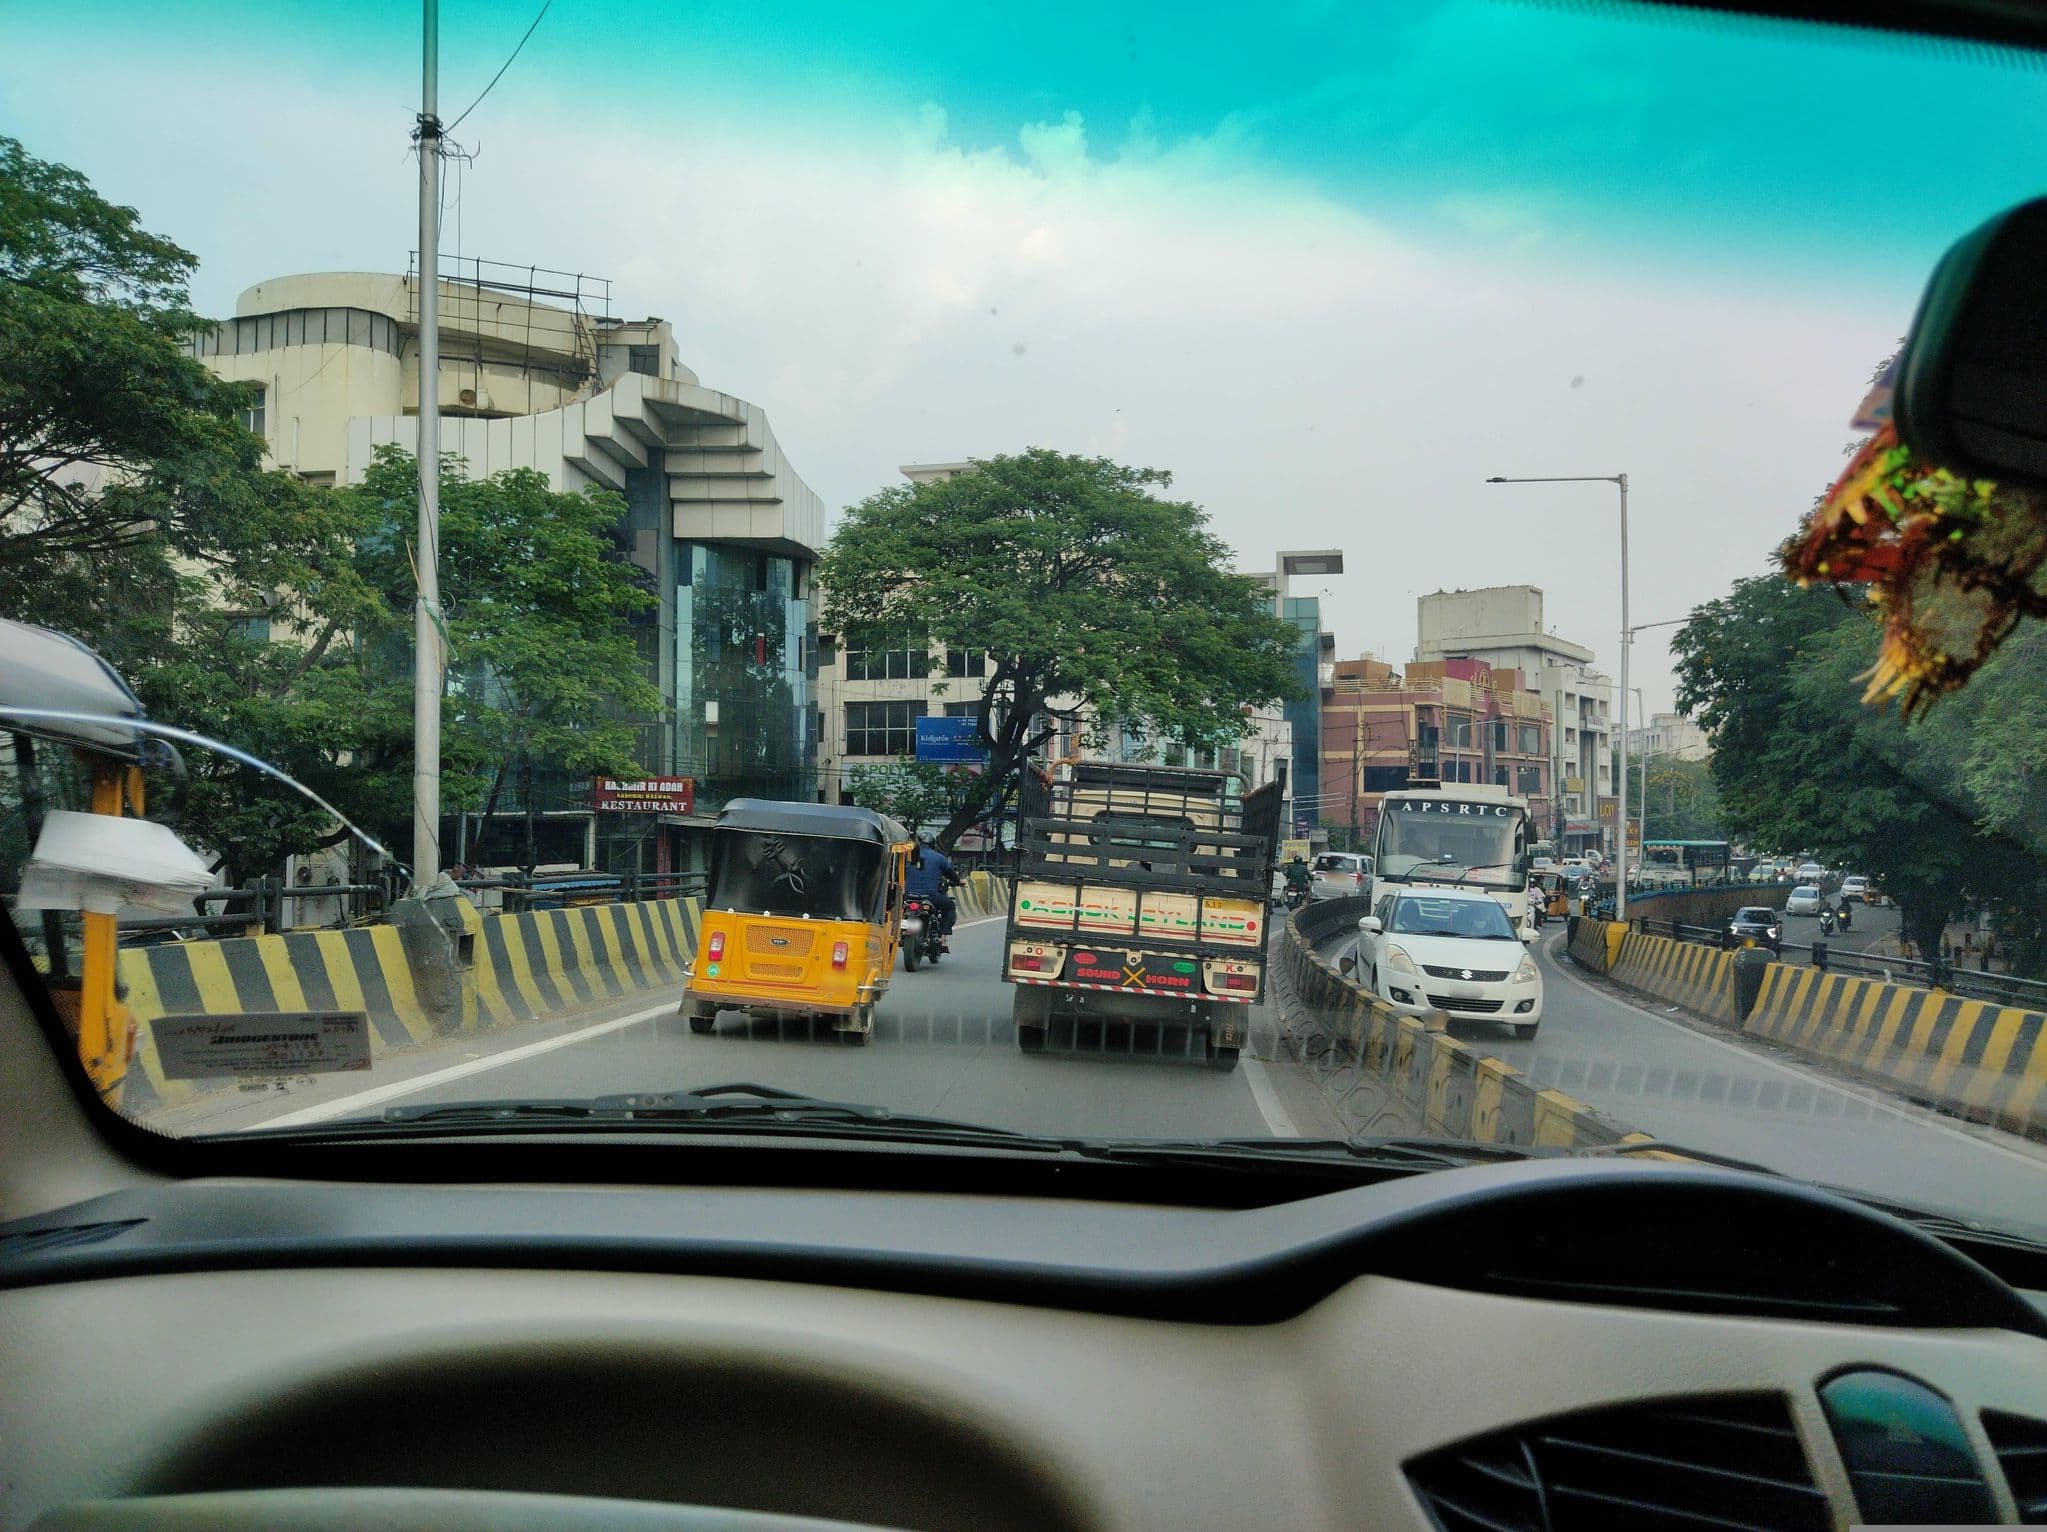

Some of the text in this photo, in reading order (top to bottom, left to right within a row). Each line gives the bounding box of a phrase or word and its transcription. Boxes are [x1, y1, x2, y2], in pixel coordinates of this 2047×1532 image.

[648, 781, 657, 792] KI
[601, 800, 687, 812] RESTAURANT
[1077, 968, 1190, 987] SOUND HORN
